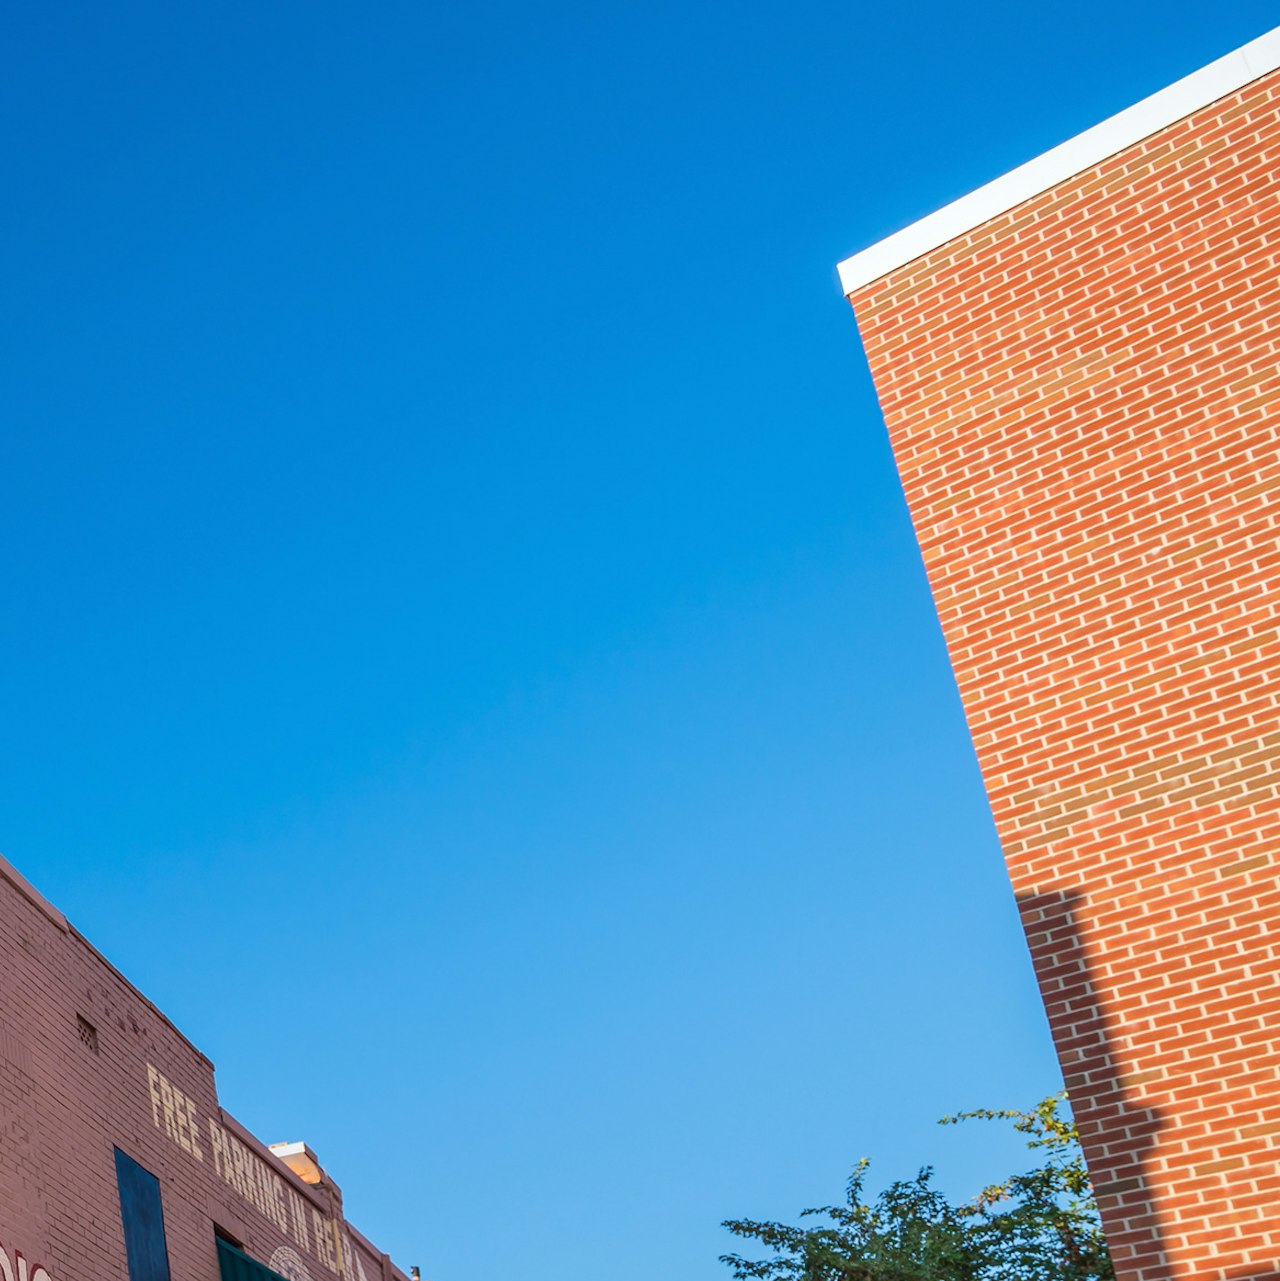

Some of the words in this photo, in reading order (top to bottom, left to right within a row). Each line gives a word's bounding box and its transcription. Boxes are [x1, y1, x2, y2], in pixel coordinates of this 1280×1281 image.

[146, 1062, 204, 1163] FREE
[209, 1117, 288, 1235] PARKING
[288, 1188, 310, 1252] IN
